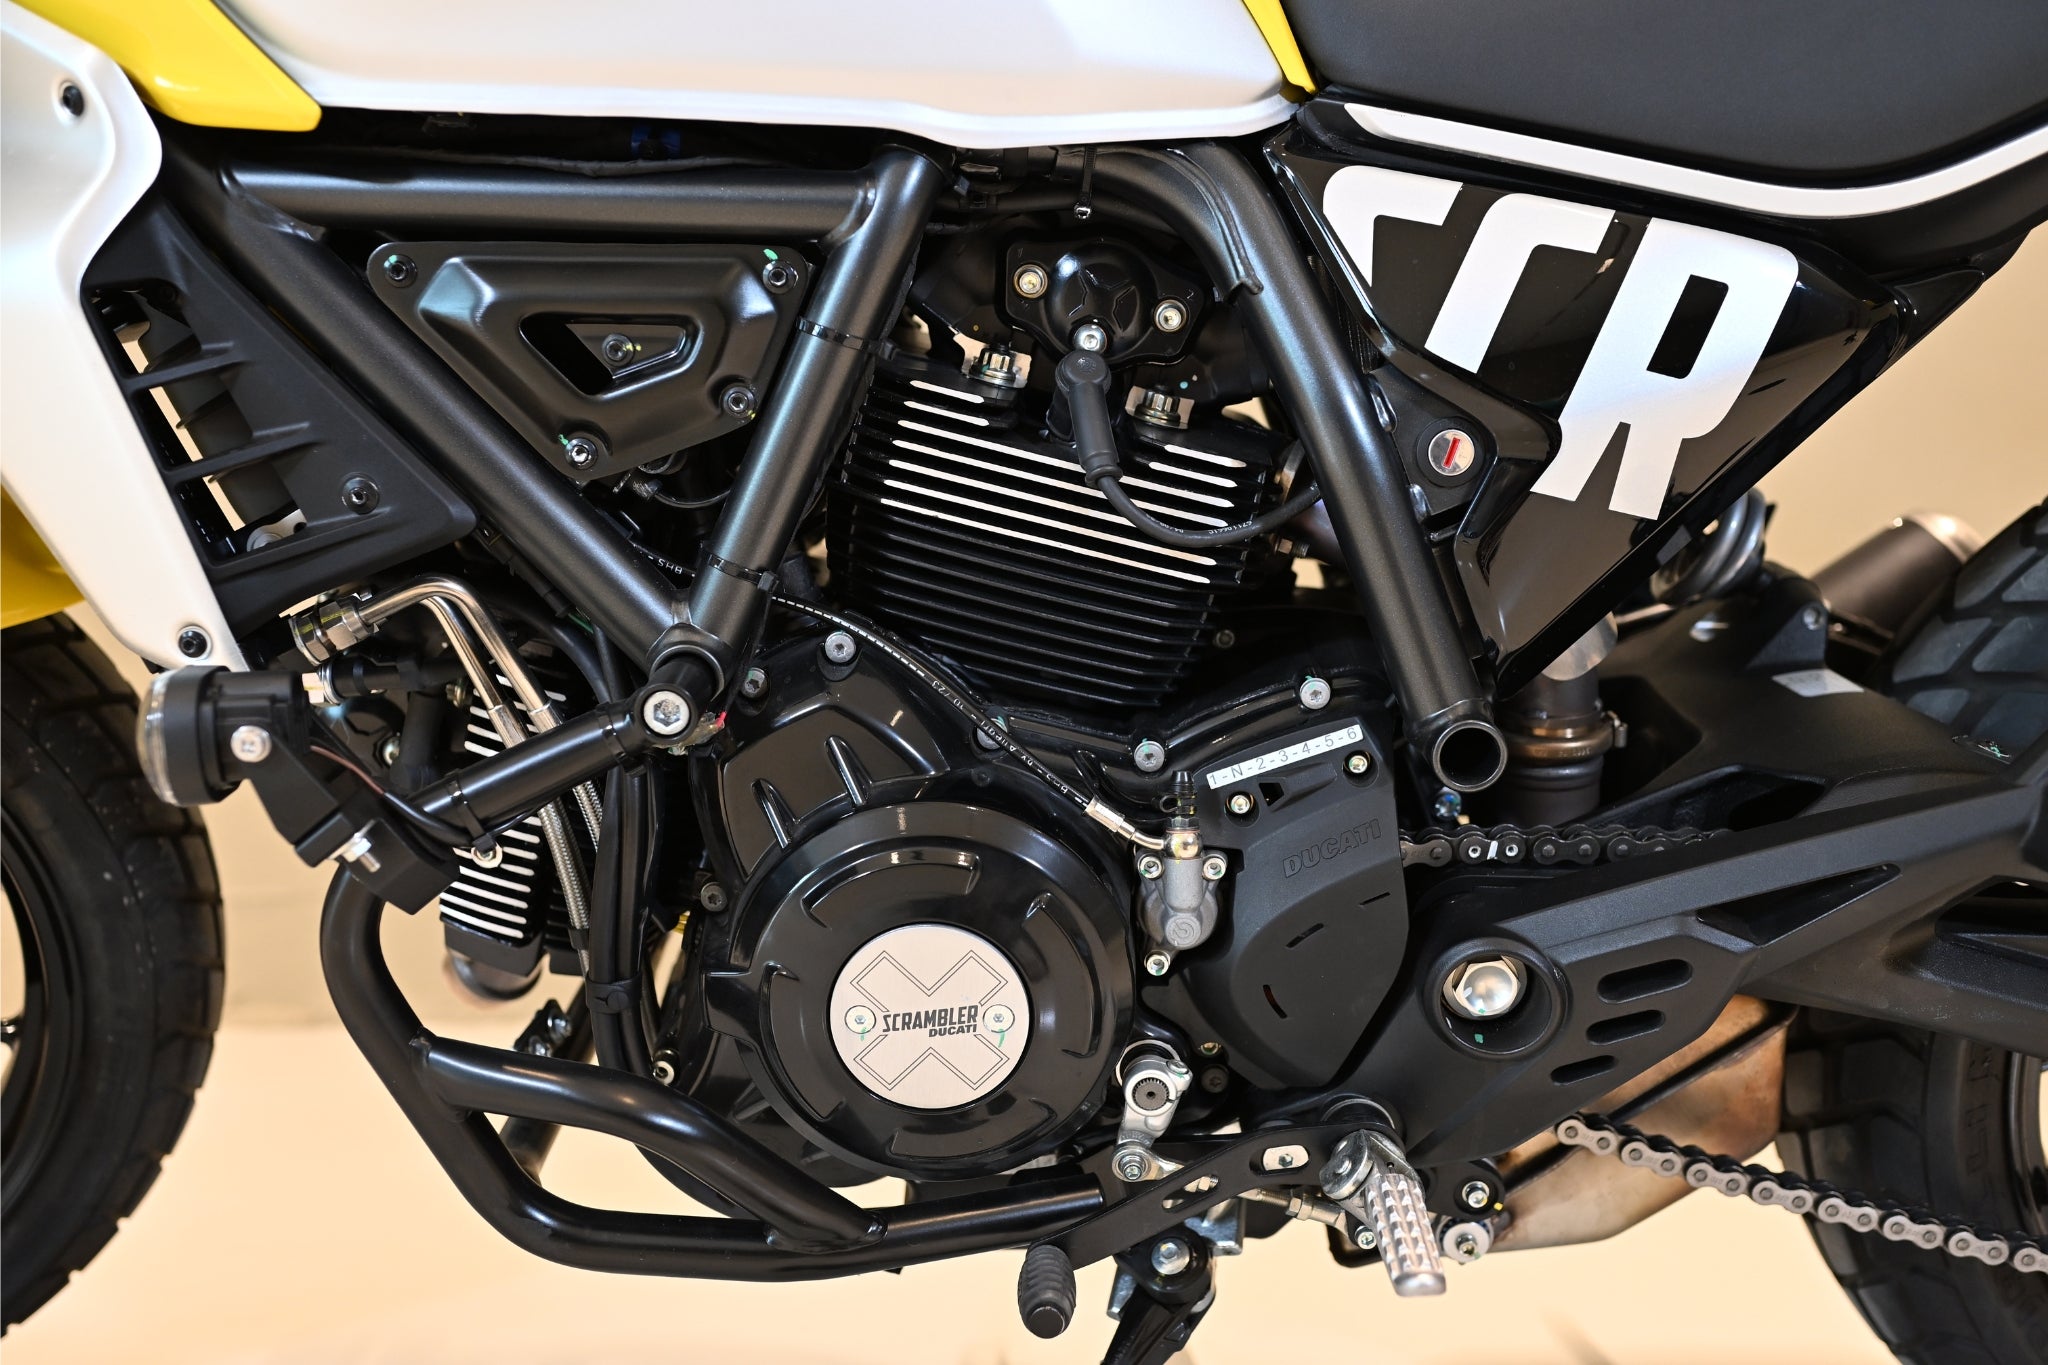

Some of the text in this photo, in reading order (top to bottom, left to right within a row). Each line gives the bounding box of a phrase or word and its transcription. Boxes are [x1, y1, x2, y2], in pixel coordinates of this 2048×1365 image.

[1282, 818, 1382, 878] DUCATI
[882, 1004, 979, 1032] SCRAMBLER
[928, 1024, 977, 1038] DUCATI
